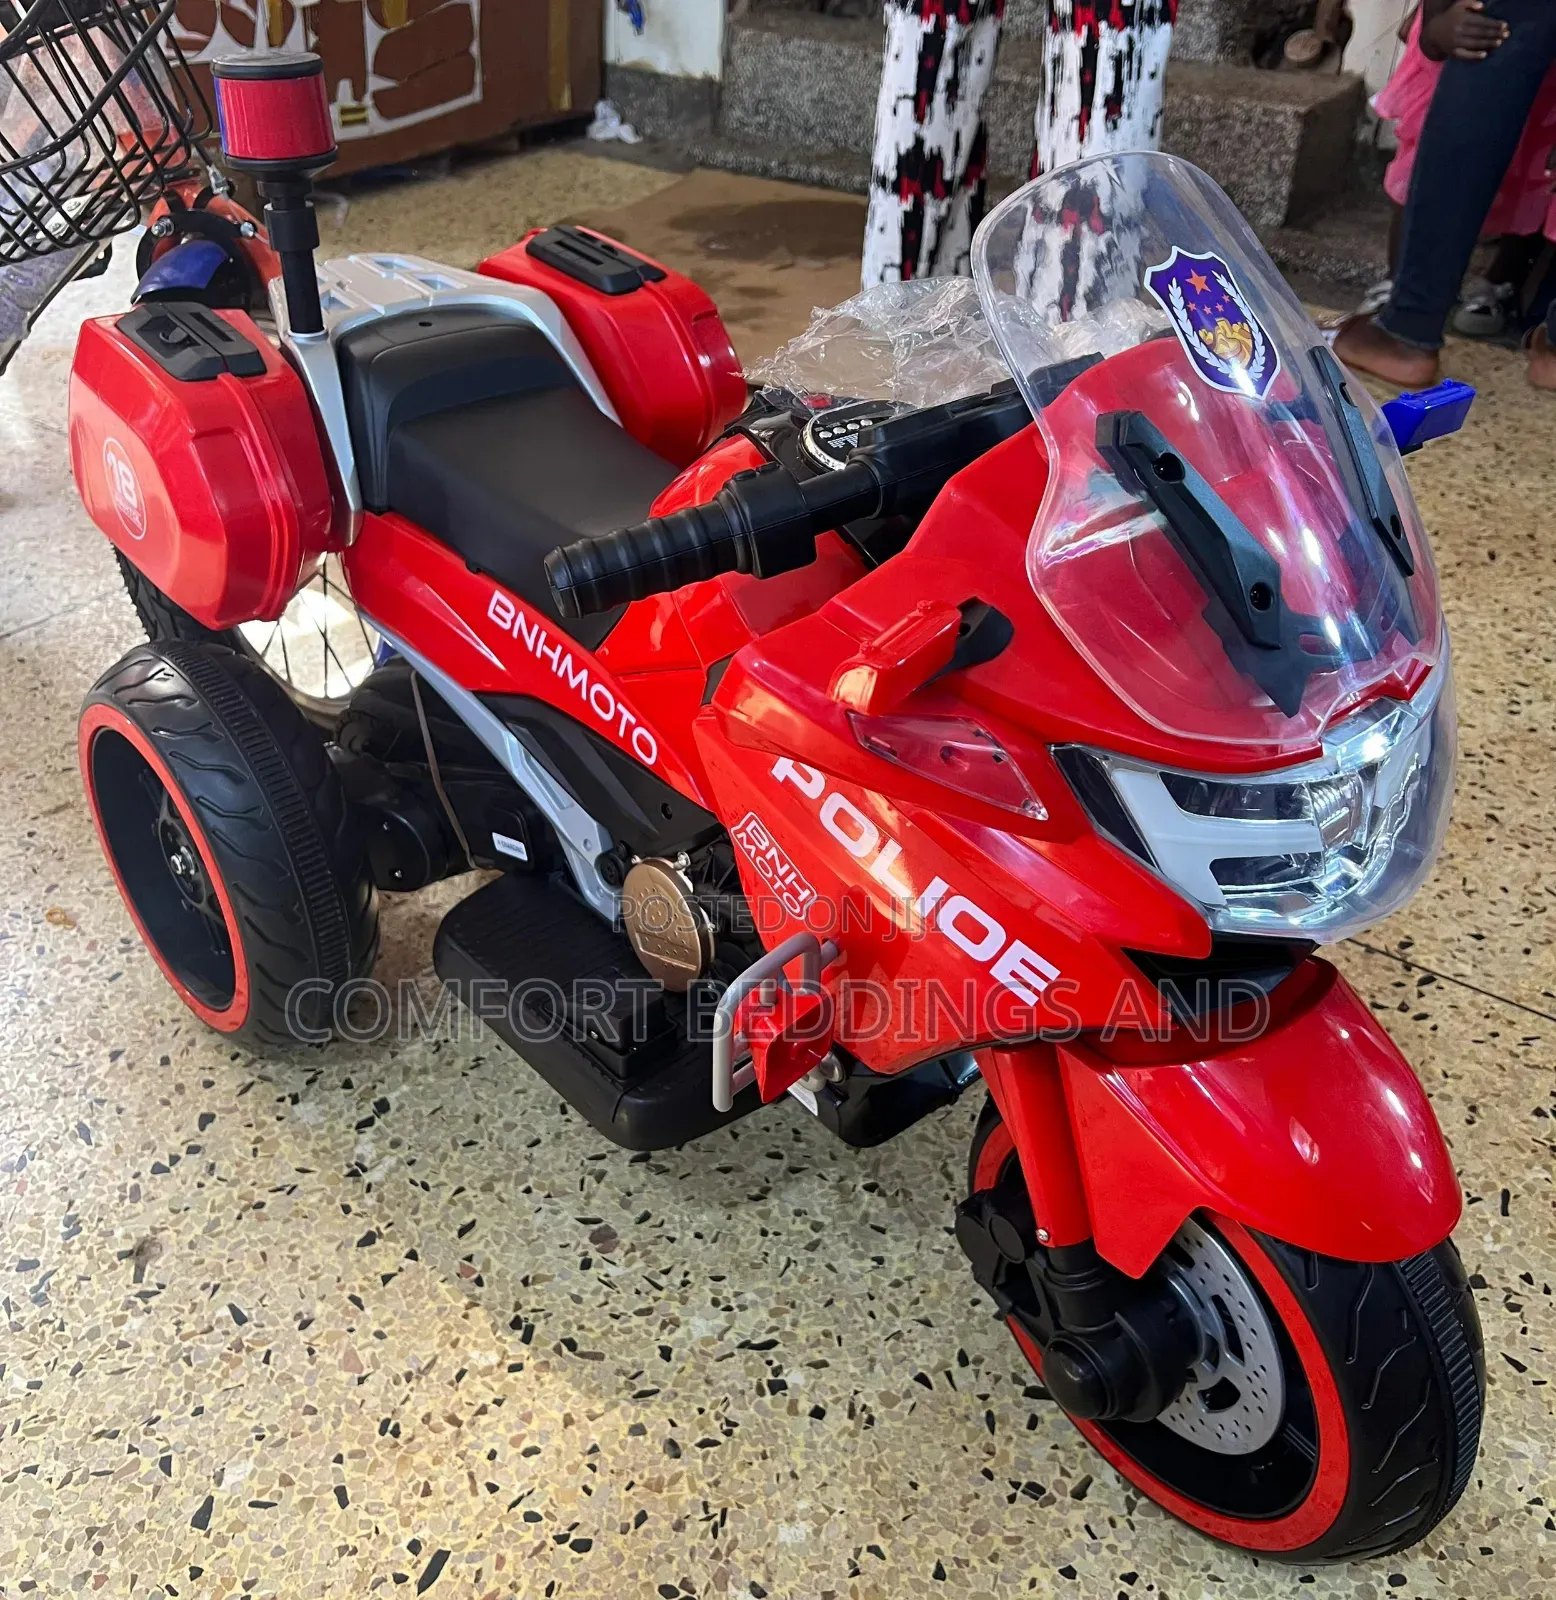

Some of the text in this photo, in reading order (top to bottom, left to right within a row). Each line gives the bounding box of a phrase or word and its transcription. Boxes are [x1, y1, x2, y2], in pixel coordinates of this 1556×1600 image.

[106, 450, 138, 509] 18
[487, 589, 658, 766] BNHMOTO
[736, 831, 801, 914] MOTO
[745, 819, 811, 903] BNH
